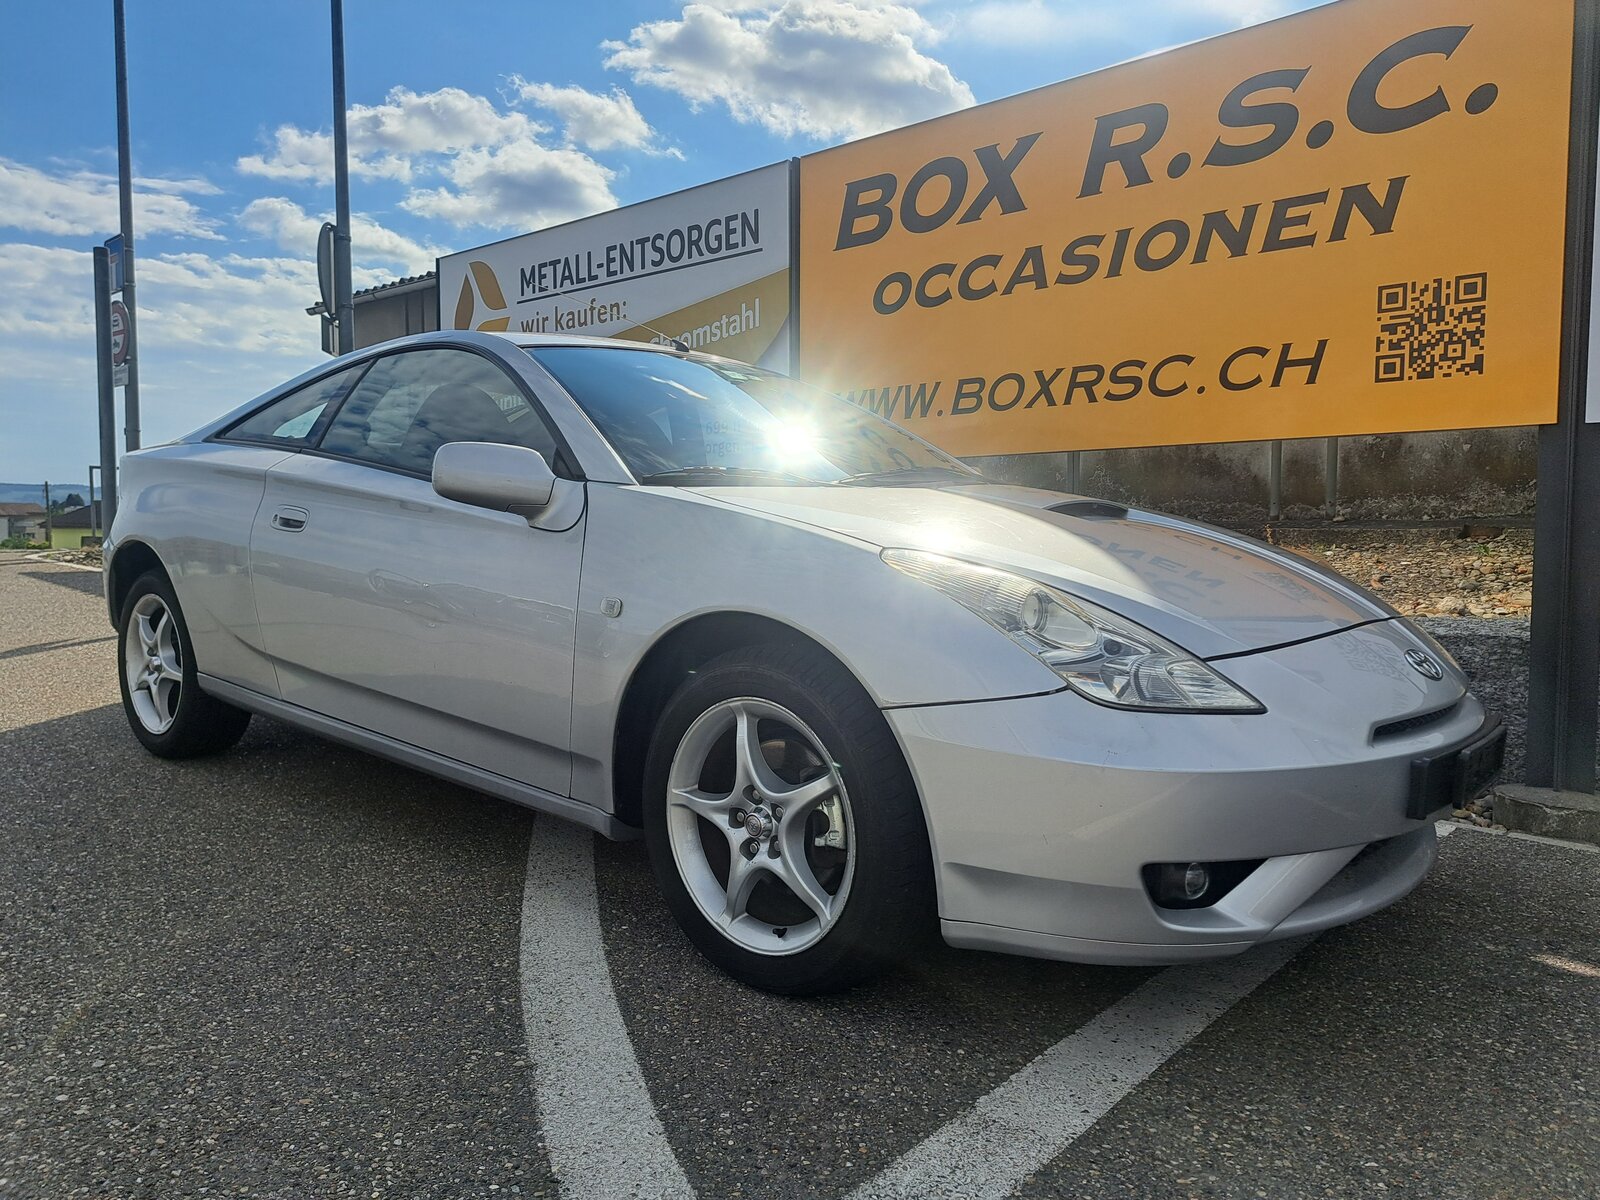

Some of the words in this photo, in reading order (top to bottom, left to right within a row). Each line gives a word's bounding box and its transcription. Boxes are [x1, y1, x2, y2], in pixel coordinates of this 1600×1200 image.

[832, 131, 1043, 252] BOX
[1076, 24, 1499, 199] R.S.C.
[519, 208, 761, 296] METALL-ENTSORGEN
[872, 175, 1411, 315] OCCASIONEN
[520, 311, 549, 332] wir
[554, 298, 627, 331] kaufen:
